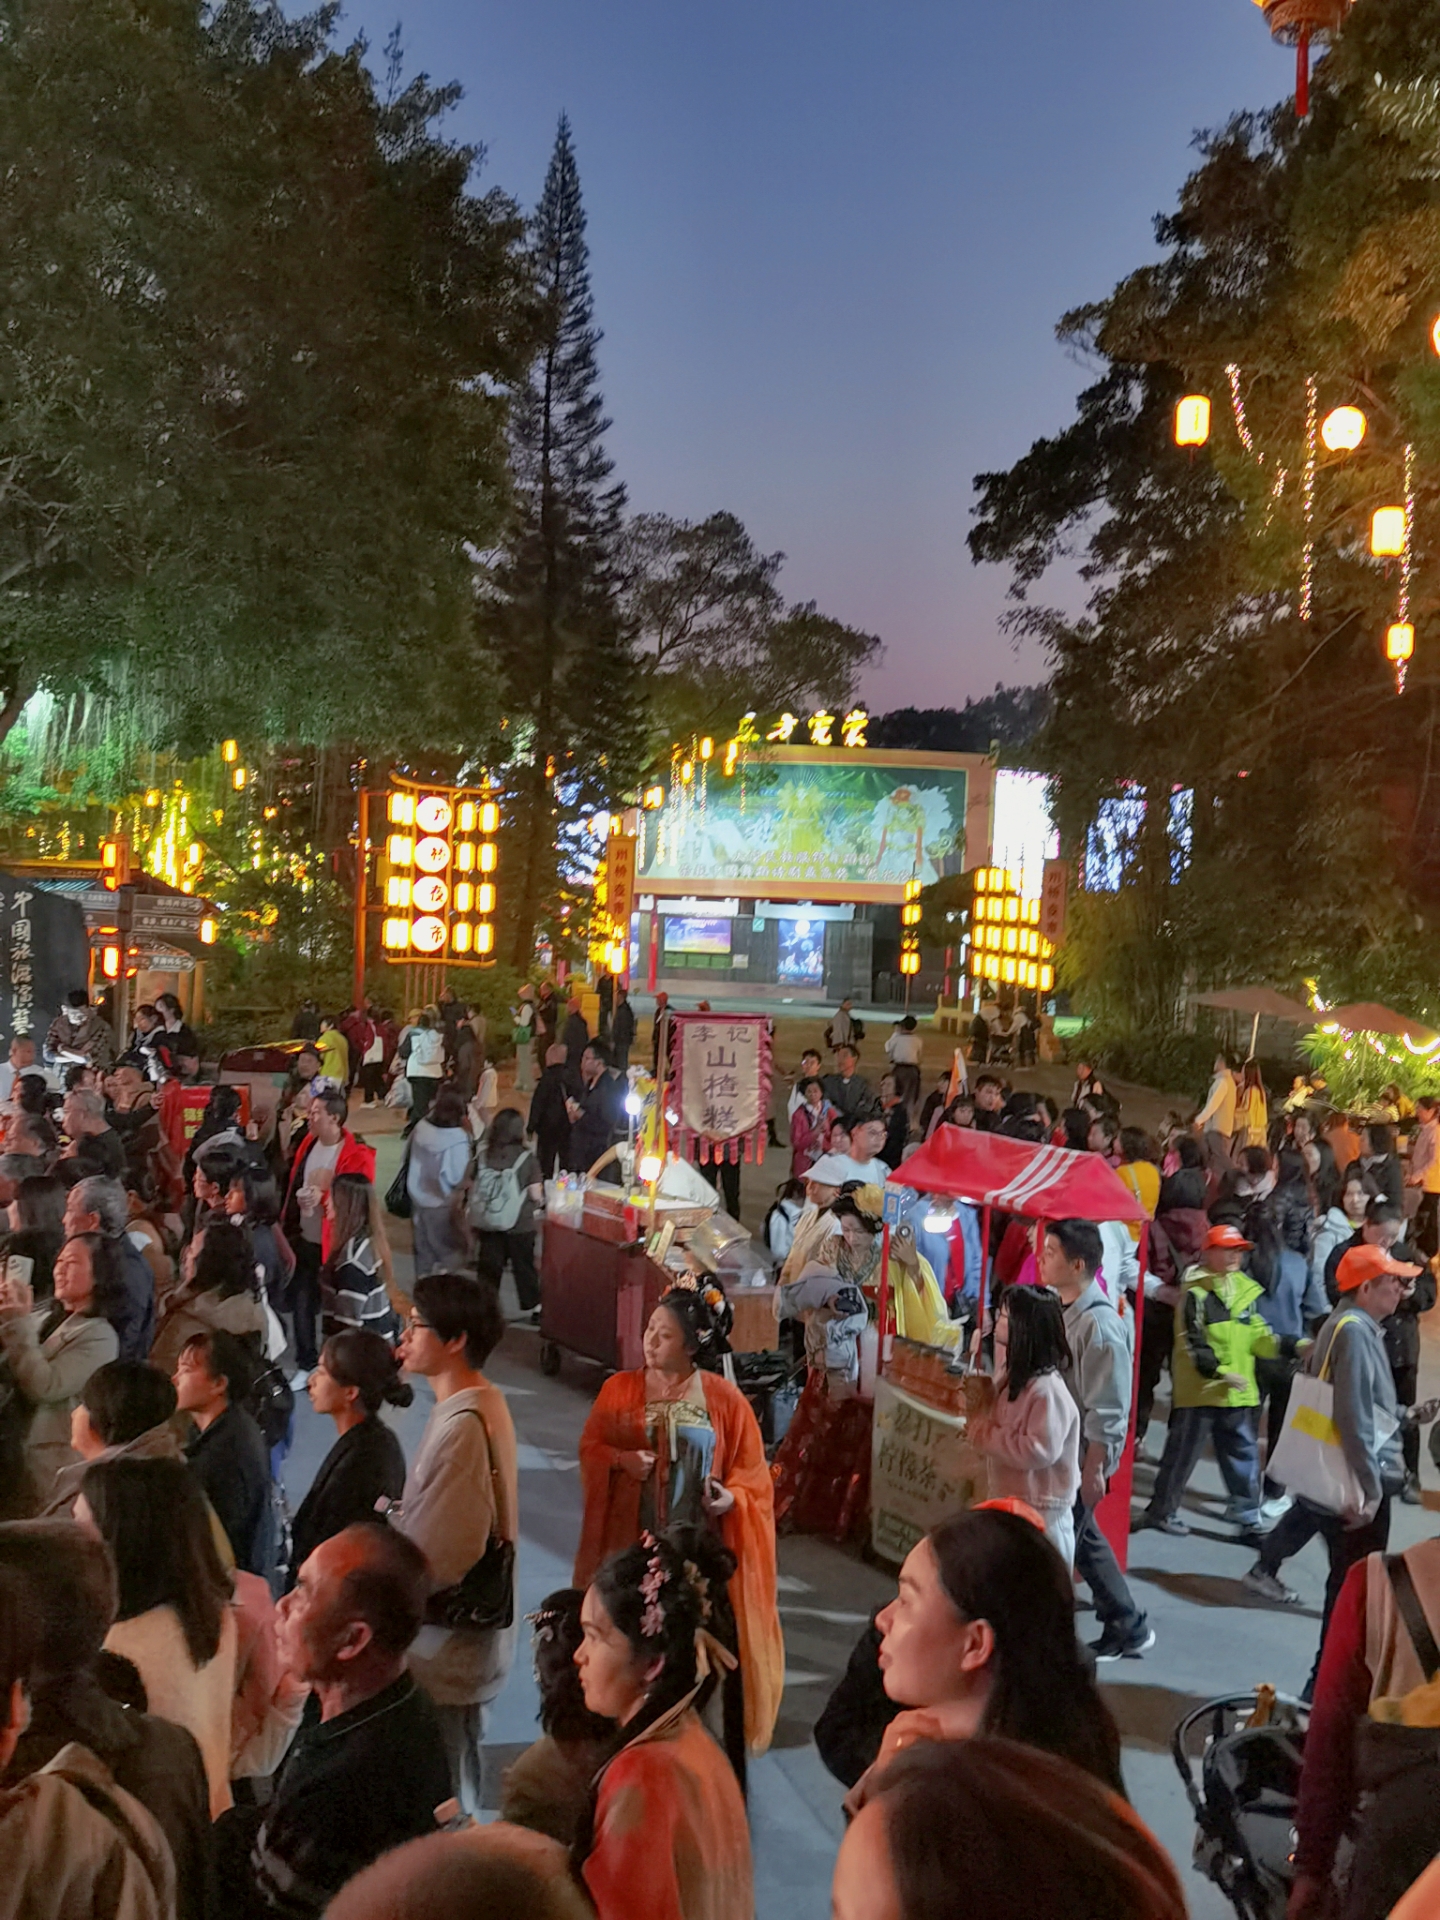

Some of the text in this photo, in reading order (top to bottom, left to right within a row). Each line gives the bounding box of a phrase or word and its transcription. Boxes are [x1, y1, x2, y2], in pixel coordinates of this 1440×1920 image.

[690, 1024, 752, 1043] 李记
[701, 1045, 742, 1131] 山楂糕
